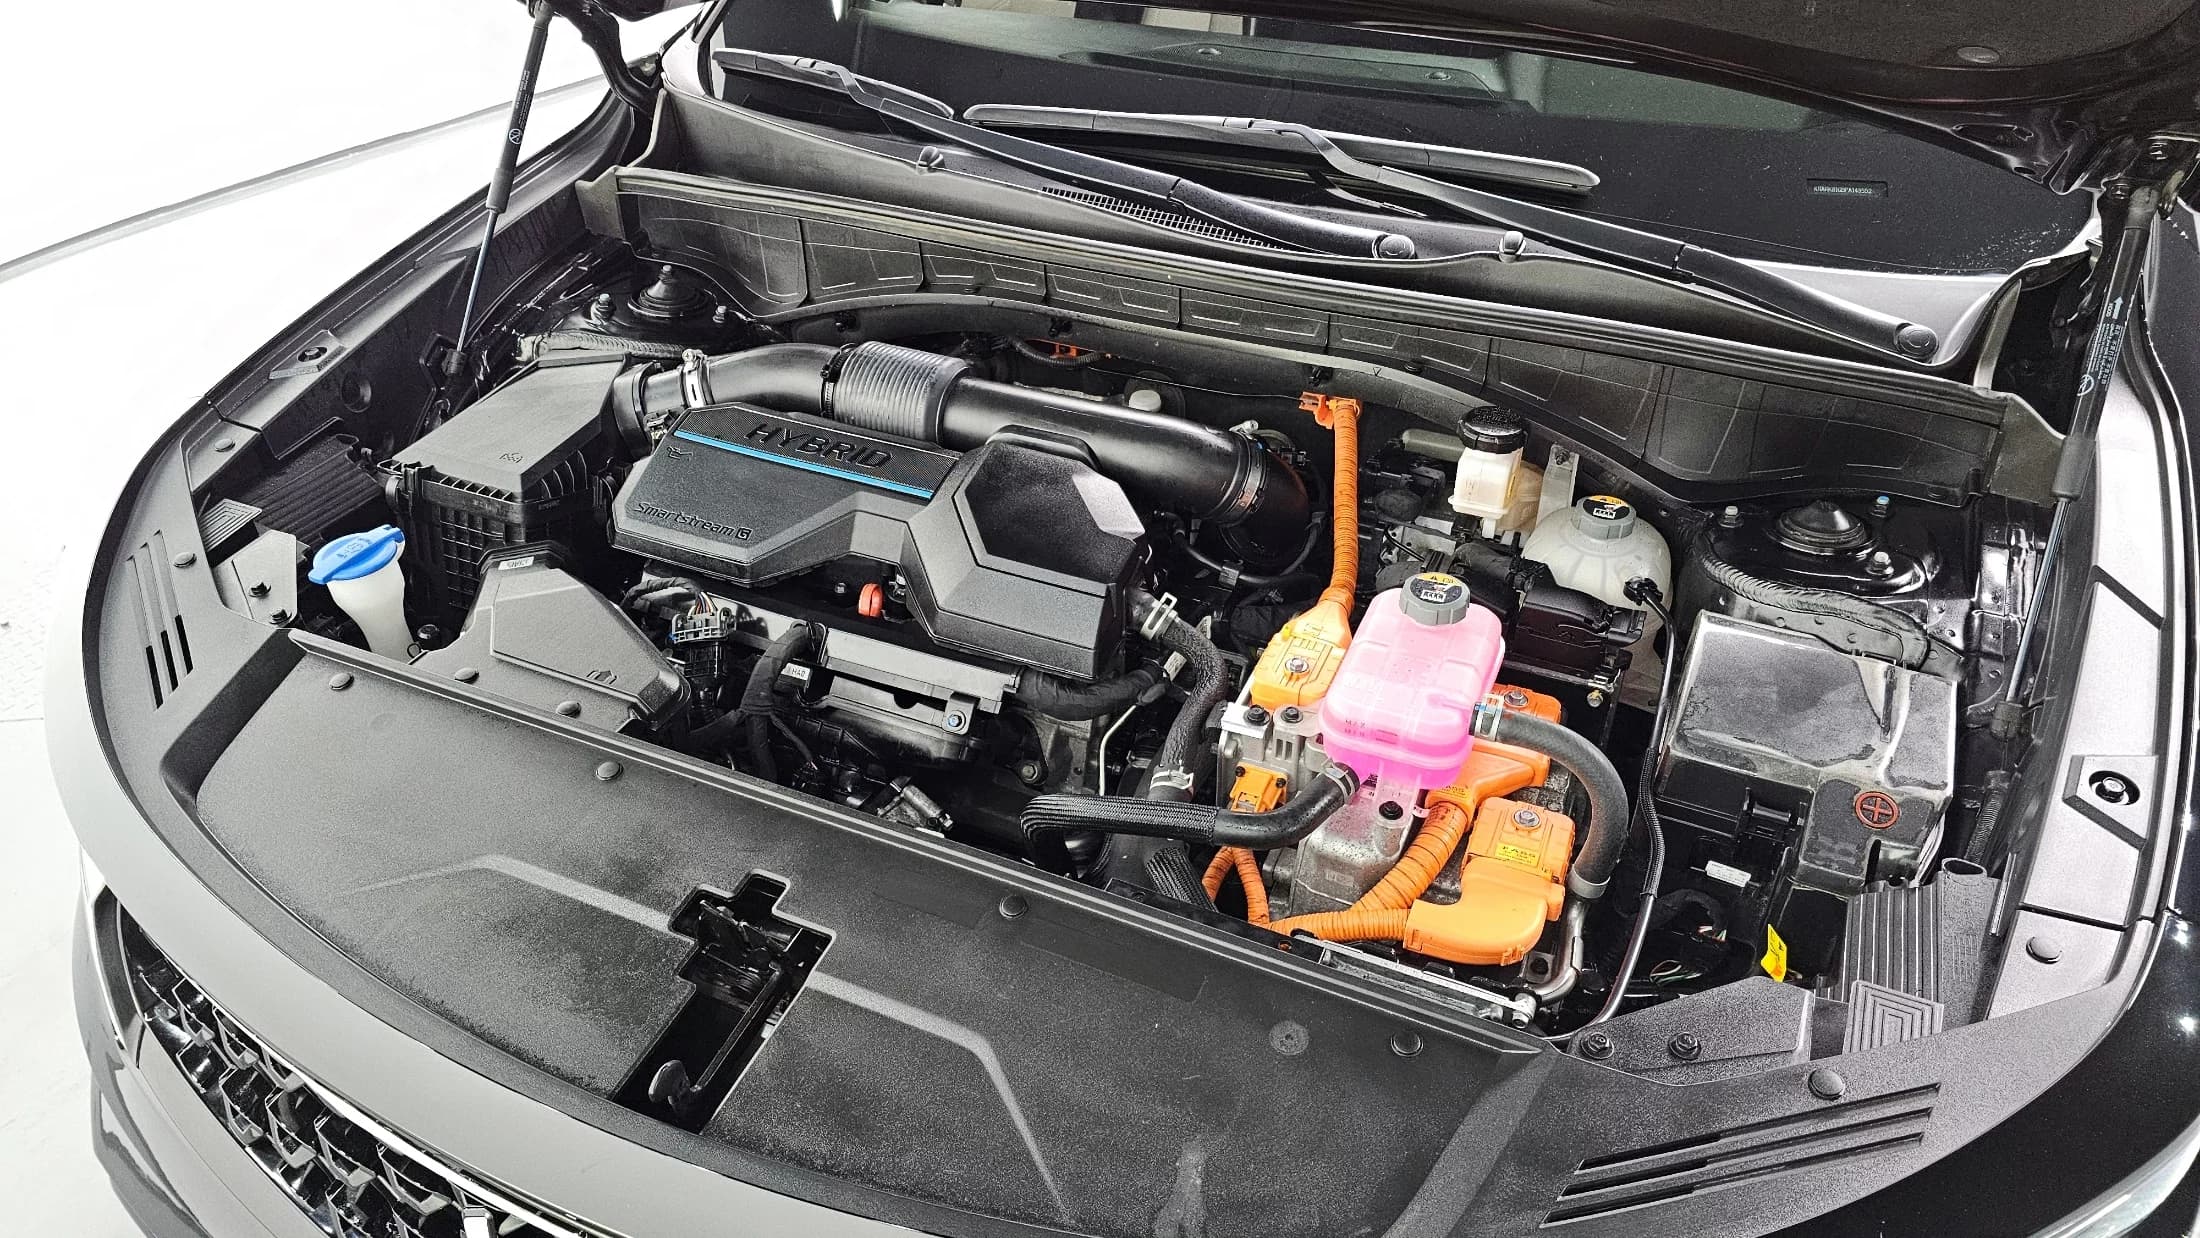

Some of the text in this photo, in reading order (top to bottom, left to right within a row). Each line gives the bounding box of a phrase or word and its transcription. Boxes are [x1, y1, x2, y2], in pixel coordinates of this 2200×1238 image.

[743, 422, 894, 469] HYBRID
[633, 501, 752, 541] Smartstream G
